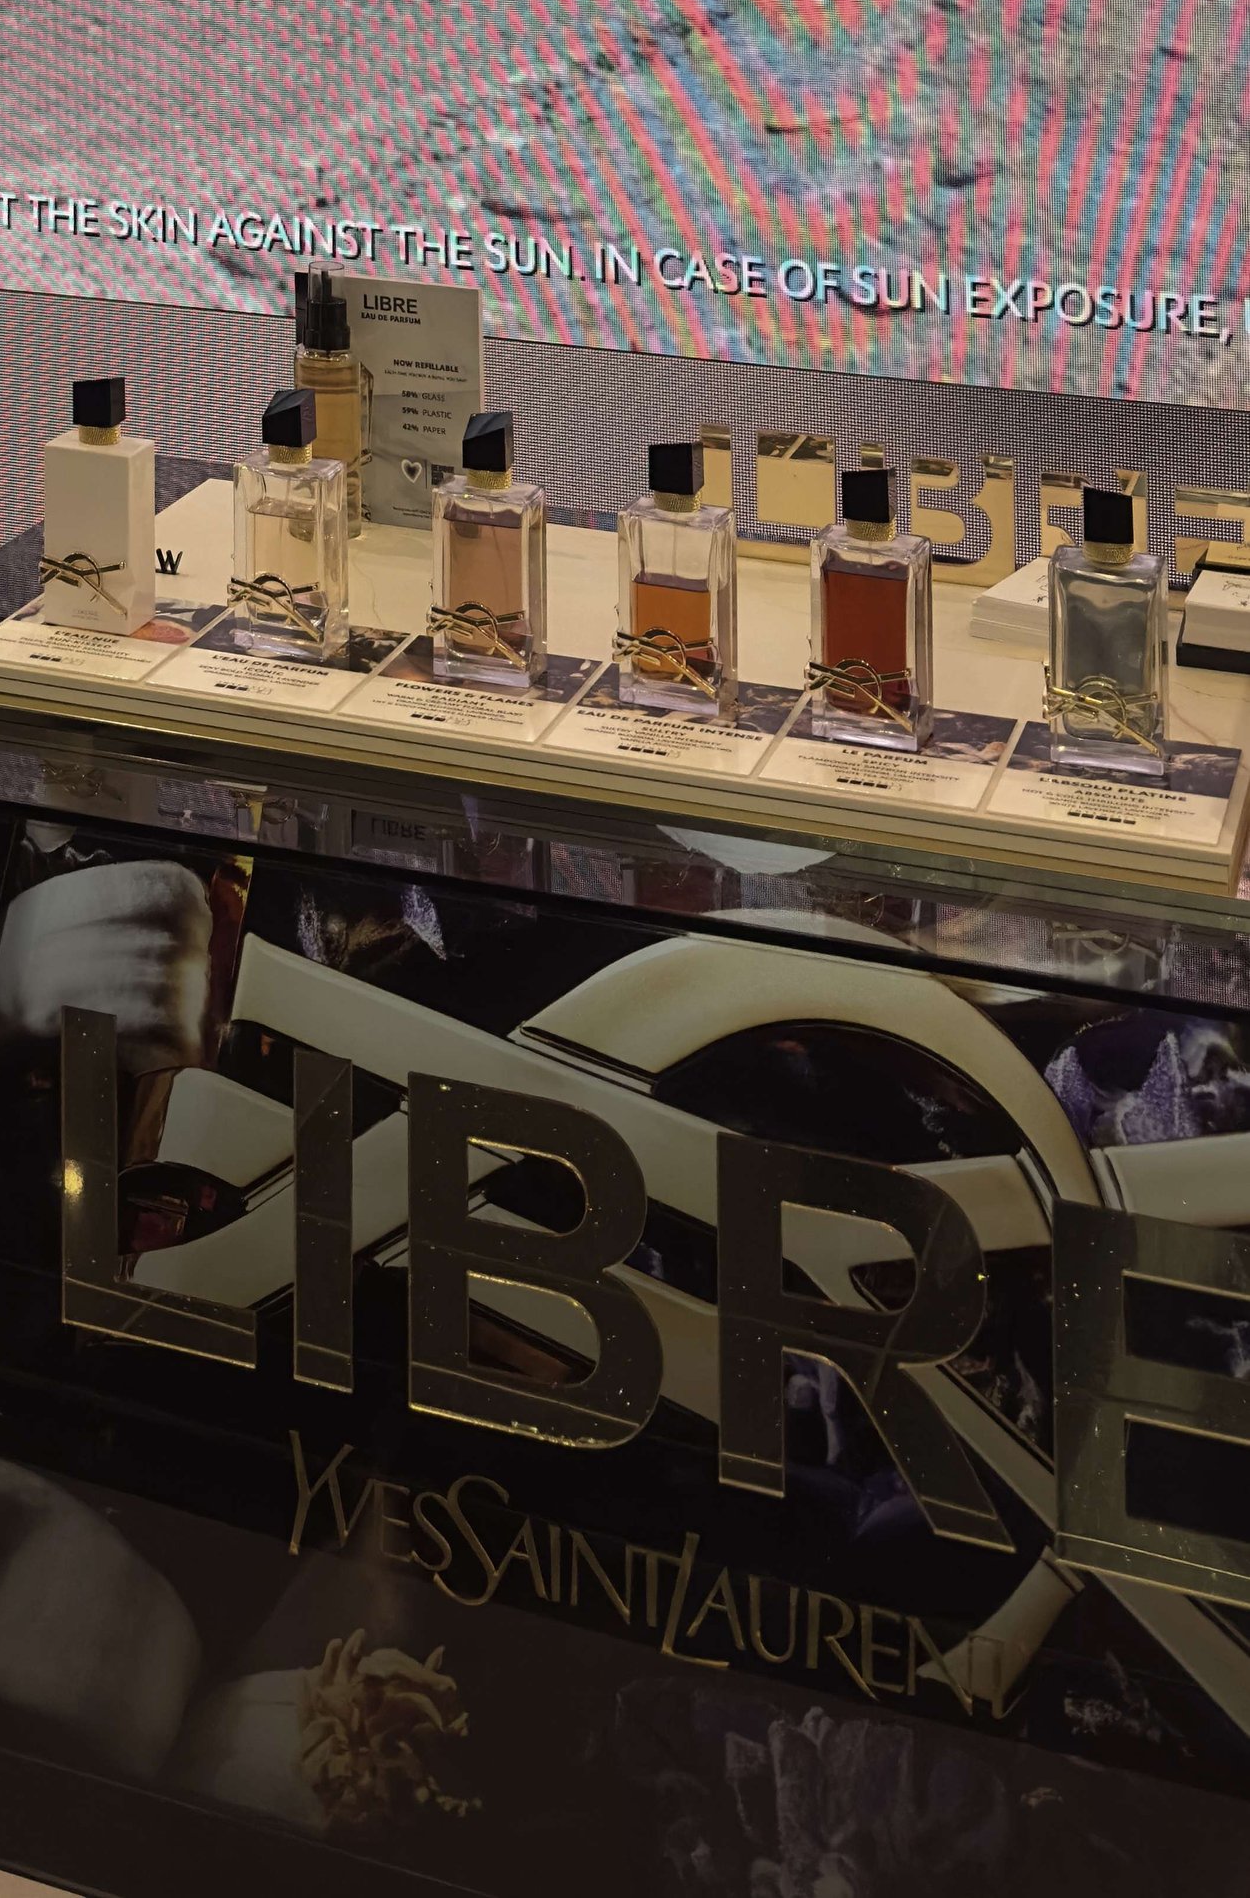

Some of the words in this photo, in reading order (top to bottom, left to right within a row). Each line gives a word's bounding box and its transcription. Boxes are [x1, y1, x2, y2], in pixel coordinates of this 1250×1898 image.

[30, 195, 101, 238] THE
[108, 200, 199, 248] SKIN
[209, 210, 383, 262] AGAINST
[393, 224, 477, 272] THE
[487, 236, 587, 282] SUN.
[594, 244, 643, 287] IN
[655, 247, 767, 298] CASE
[777, 257, 846, 303] OF
[851, 264, 951, 315] SUN
[965, 275, 1234, 347] EXPOSURE,
[363, 294, 418, 314] LIBRE
[361, 312, 376, 321] EAU
[390, 315, 421, 325] PARFUM
[393, 359, 412, 367] NOW
[415, 362, 459, 373] REFILLABLE
[422, 392, 446, 402] GLASS
[422, 409, 452, 419] PLASTIC
[423, 425, 446, 434] PAPER
[55, 631, 90, 639] L'EAU
[212, 655, 248, 663] L'EAU
[273, 664, 329, 675] PARFUM
[243, 667, 284, 675] ICONIC
[395, 683, 461, 695] FLOWERS
[480, 695, 534, 706] FLAMES
[431, 695, 486, 706] RADIANT
[633, 718, 695, 730] PARFUM
[699, 728, 763, 740] INTENSE
[641, 727, 687, 736] SULTRY
[863, 752, 928, 764] PARFUM
[1040, 778, 1112, 790] L'ABSOLU
[1118, 788, 1187, 801] PLATINE
[1075, 790, 1145, 802] ABSOLUTE
[62, 1005, 1250, 1604] LIBRE
